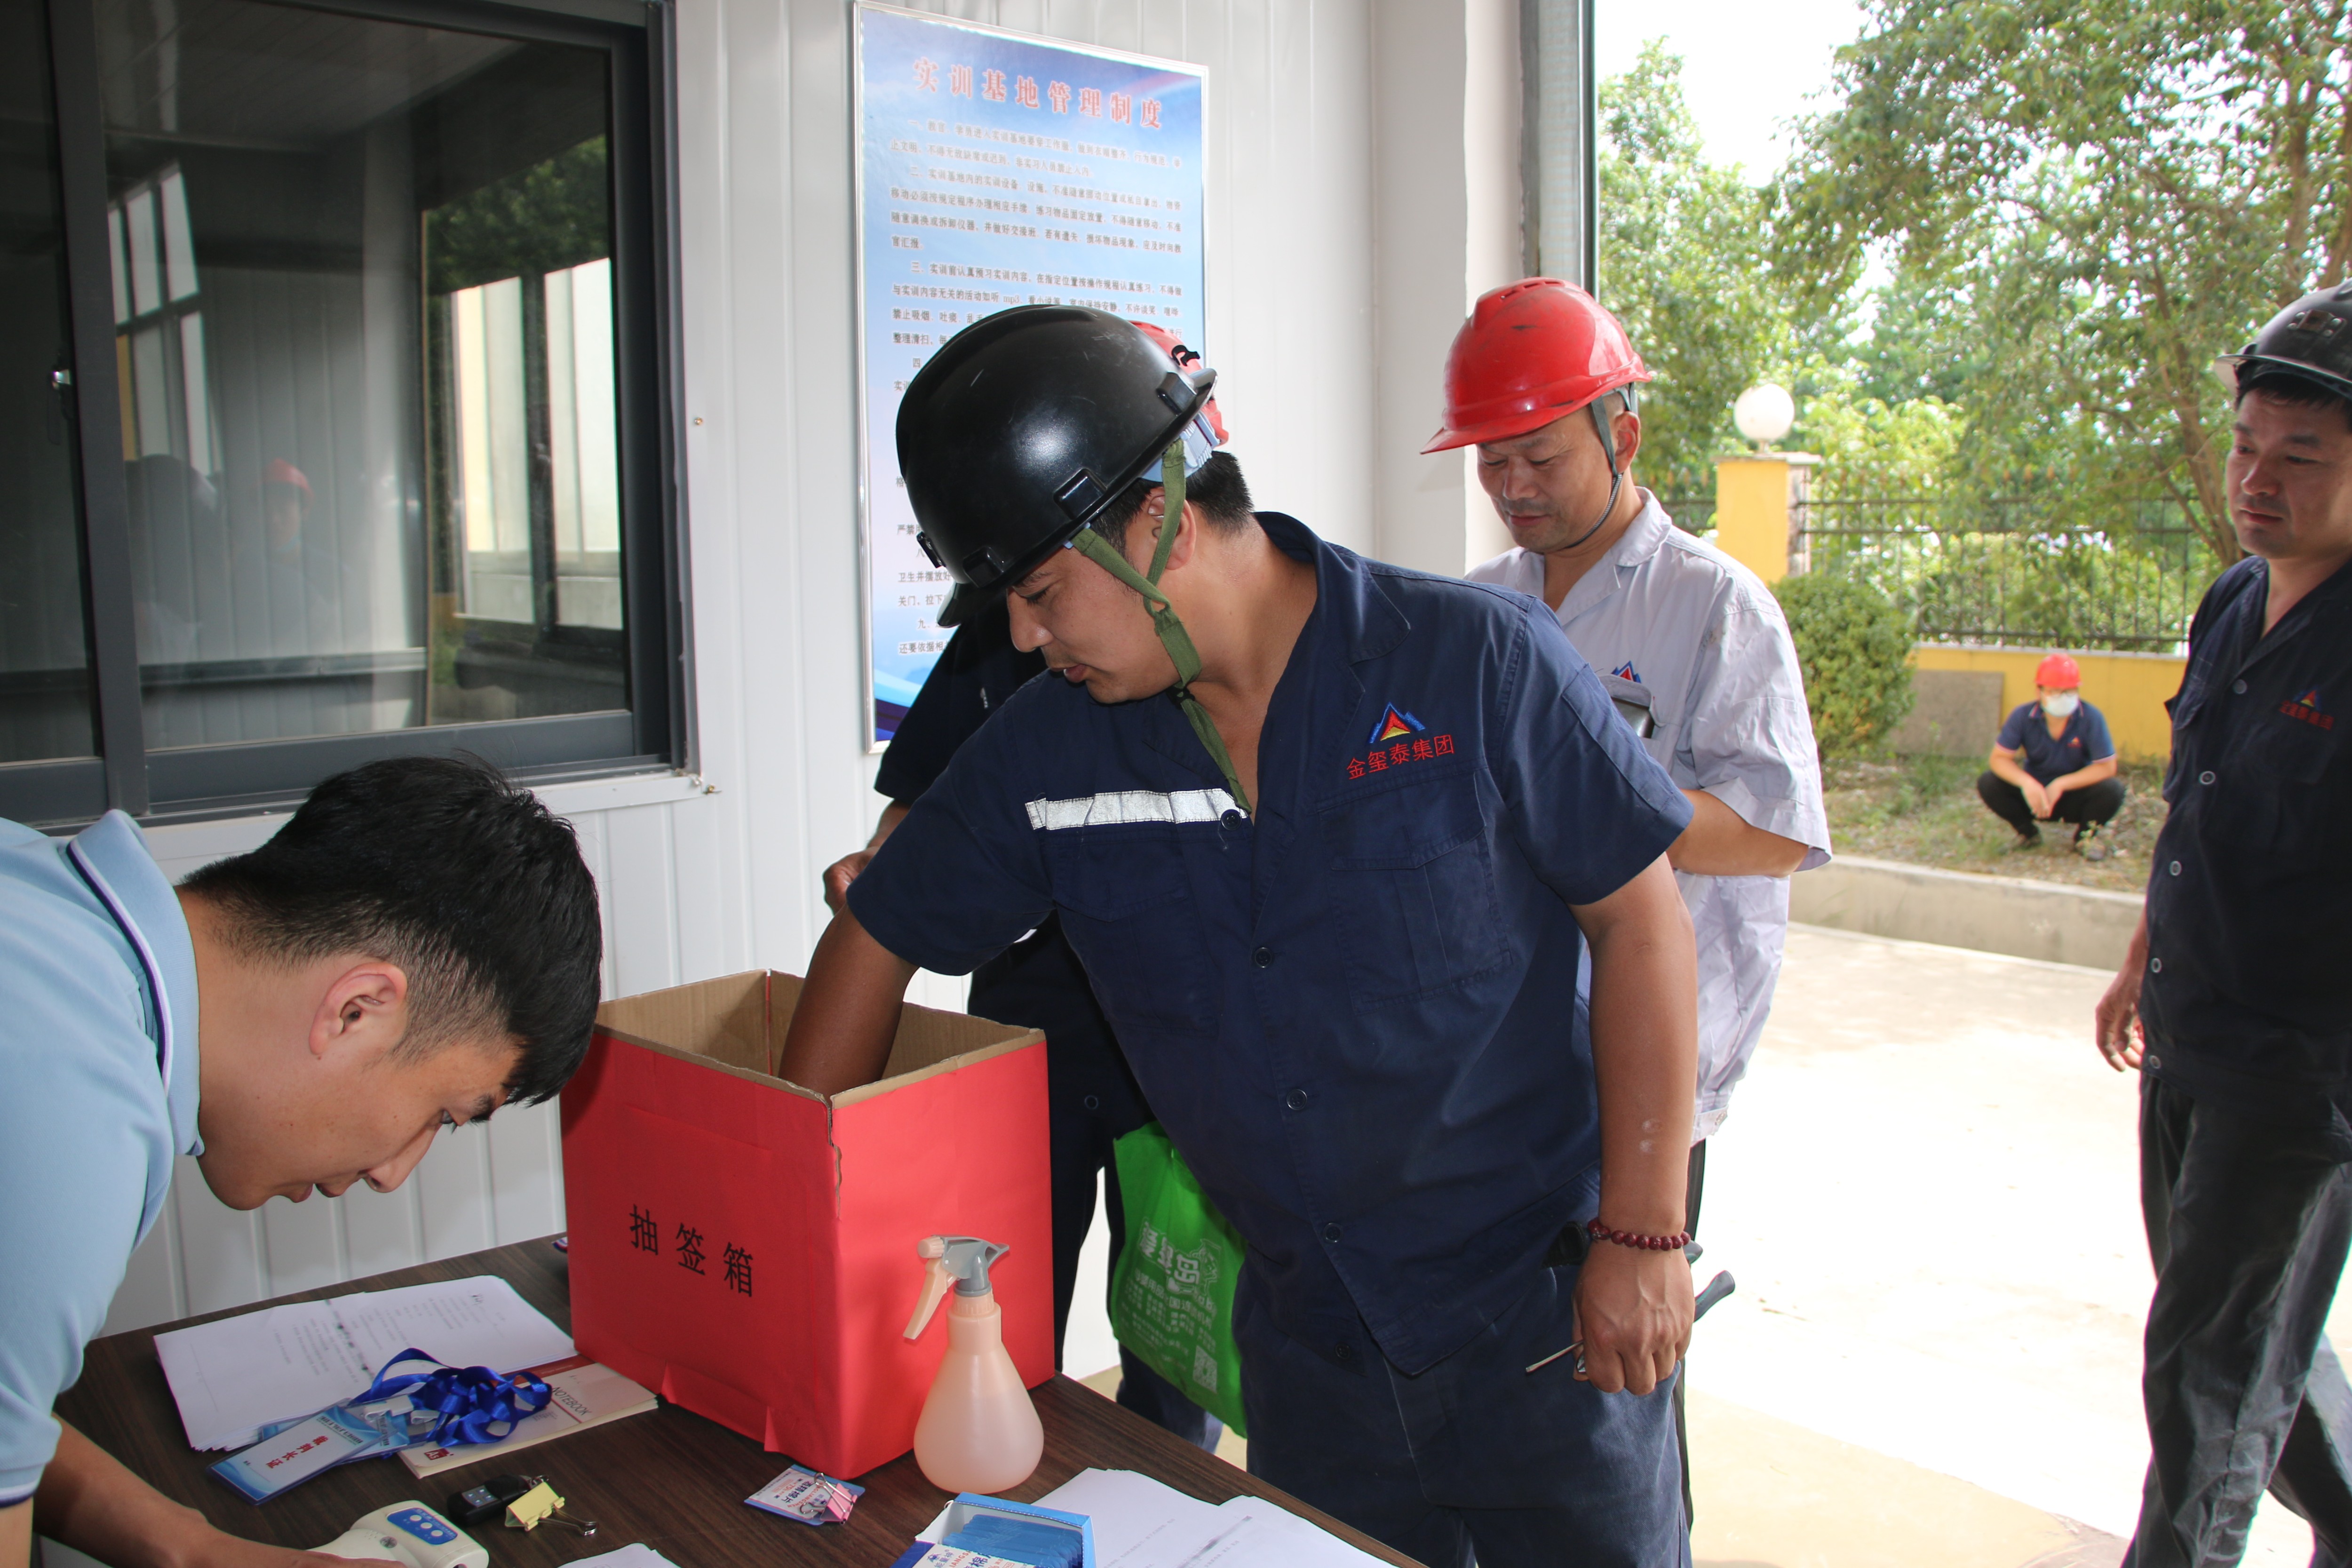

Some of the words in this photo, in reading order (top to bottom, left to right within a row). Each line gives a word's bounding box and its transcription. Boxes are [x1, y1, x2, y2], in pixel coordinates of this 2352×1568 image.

[913, 57, 1162, 129] 实训基地管理制度
[1346, 734, 1454, 780] 金玺泰集团
[629, 1204, 754, 1297] 抽签箱
[551, 1386, 593, 1416] NOTEBOOK
[781, 1480, 814, 1504] 酒精棉片
